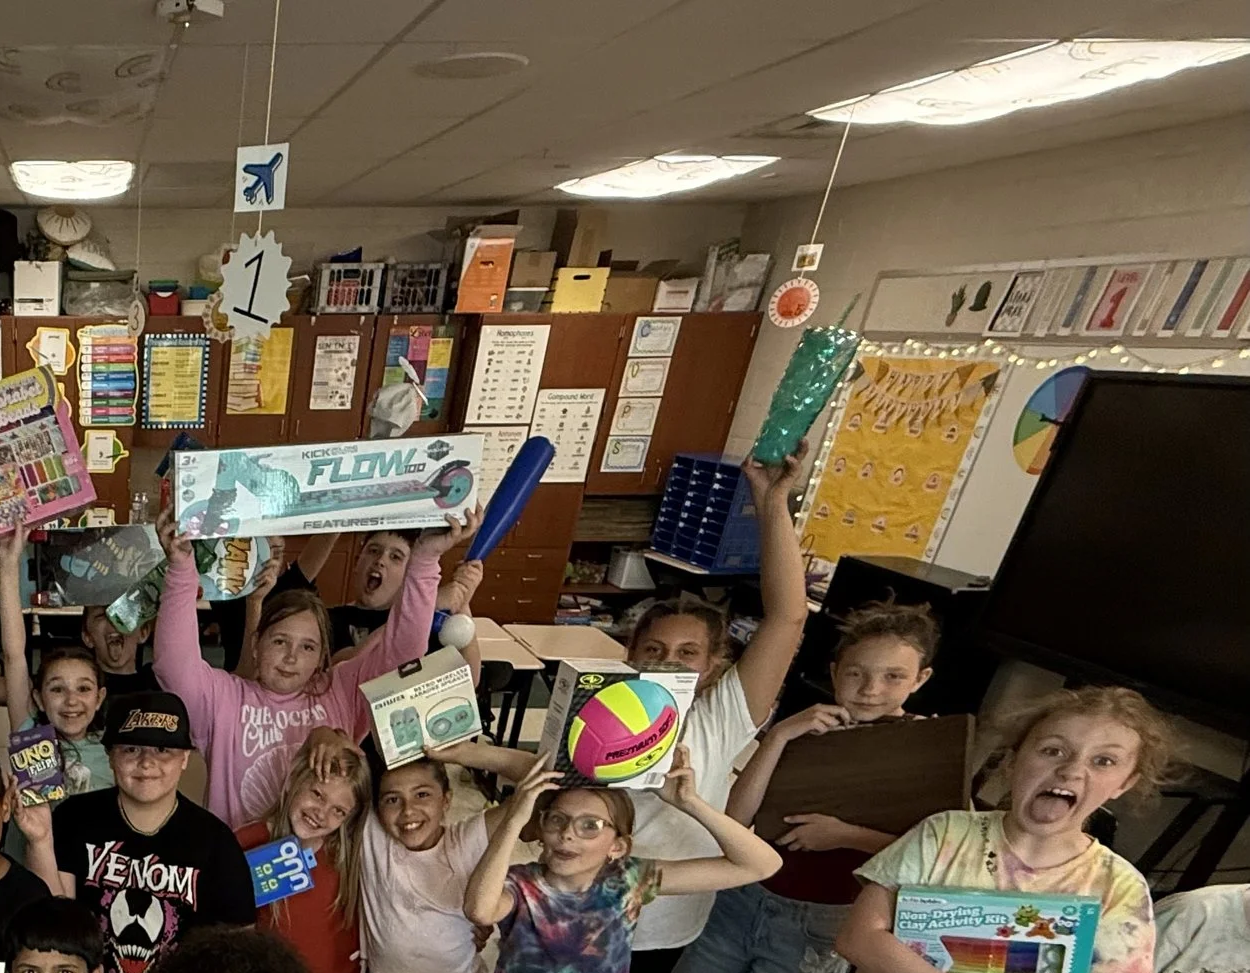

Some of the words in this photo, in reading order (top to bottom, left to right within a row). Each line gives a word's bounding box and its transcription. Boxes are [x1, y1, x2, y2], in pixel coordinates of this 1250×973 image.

[233, 250, 268, 324] 1
[133, 303, 141, 331] 3
[547, 392, 578, 401] Compound
[181, 456, 197, 466] 3+
[307, 447, 417, 486] FLOW
[404, 463, 427, 474] 100
[302, 516, 385, 530] FEATURES:
[119, 709, 180, 733] LAKERS
[241, 704, 273, 726] THE
[242, 721, 283, 757] Club
[605, 733, 658, 760] PREMIUM
[10, 740, 54, 771] UNO
[85, 840, 200, 909] VENOM
[899, 906, 981, 920] Non-Drying
[899, 919, 928, 931] Clay
[929, 915, 983, 929] Activity
[984, 914, 1008, 925] Kit
